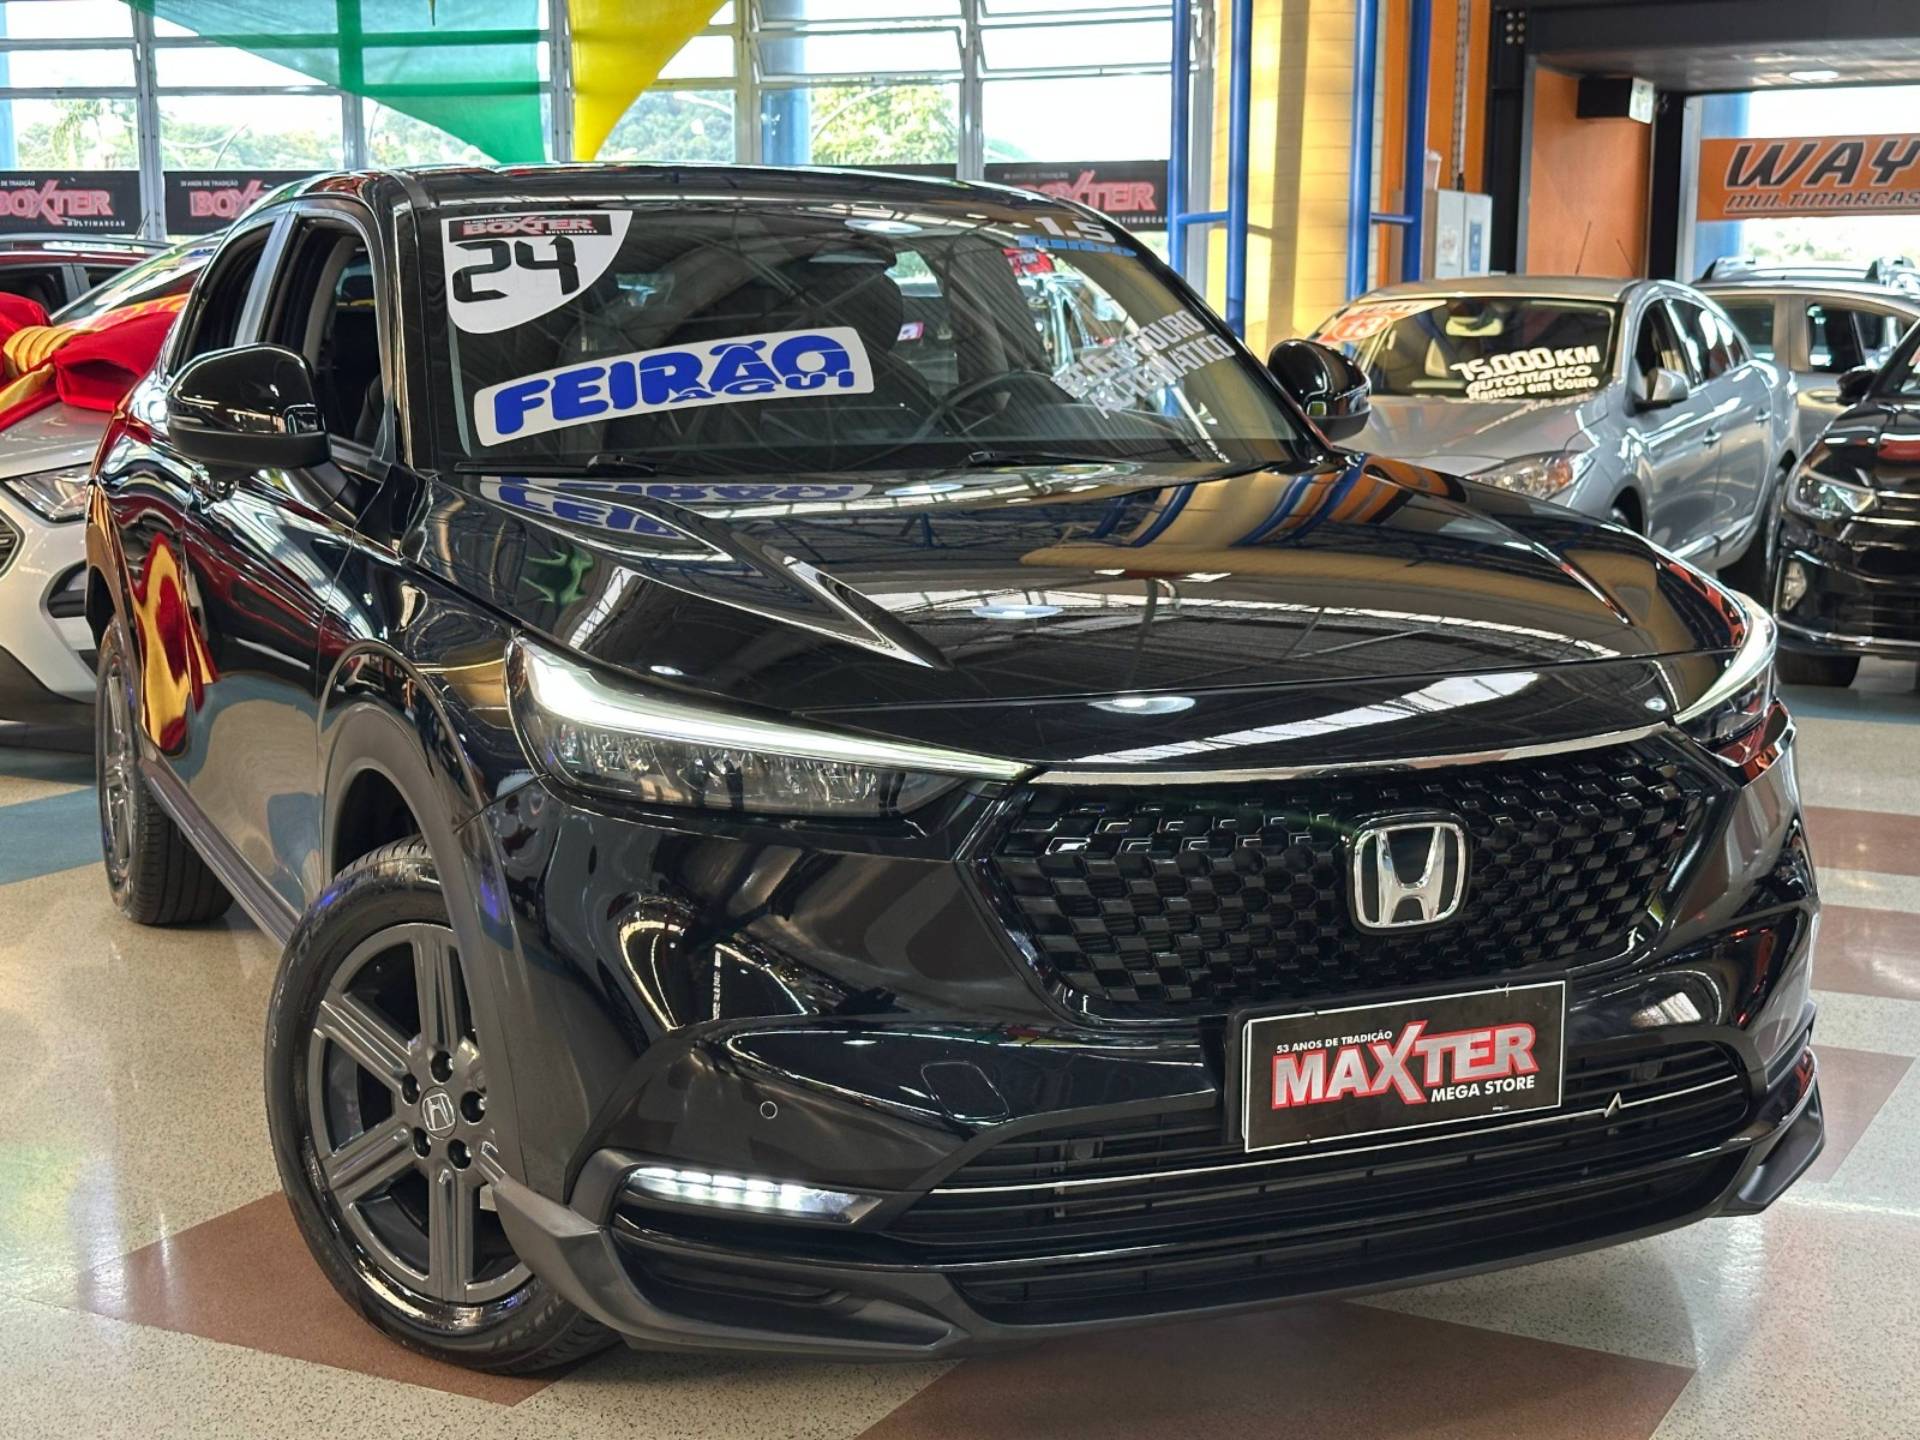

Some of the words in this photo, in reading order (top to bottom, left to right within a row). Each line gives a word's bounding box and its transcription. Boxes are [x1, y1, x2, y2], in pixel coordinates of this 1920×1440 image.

[1725, 138, 1920, 189] WAY
[189, 180, 264, 219] BOX
[1727, 191, 1920, 209] MULTIMARCAS
[462, 215, 594, 236] BOXTER
[1035, 217, 1115, 243] 1.5
[1113, 216, 1168, 225] LTIMARCAS
[452, 235, 580, 303] 24
[1125, 310, 1205, 355] COURO
[494, 334, 850, 435] FEIRÃO
[669, 371, 854, 403] AQUI
[1527, 382, 1551, 393] em
[1553, 376, 1599, 391] Couro
[1276, 1044, 1289, 1054] 53
[1291, 1040, 1322, 1053] ANOS
[1325, 1037, 1339, 1048] DE
[1341, 1029, 1393, 1045] TRADIÇÃO
[1272, 1019, 1539, 1110] MAXTER
[1431, 1085, 1480, 1103] MEGA
[1484, 1075, 1535, 1095] STORE
